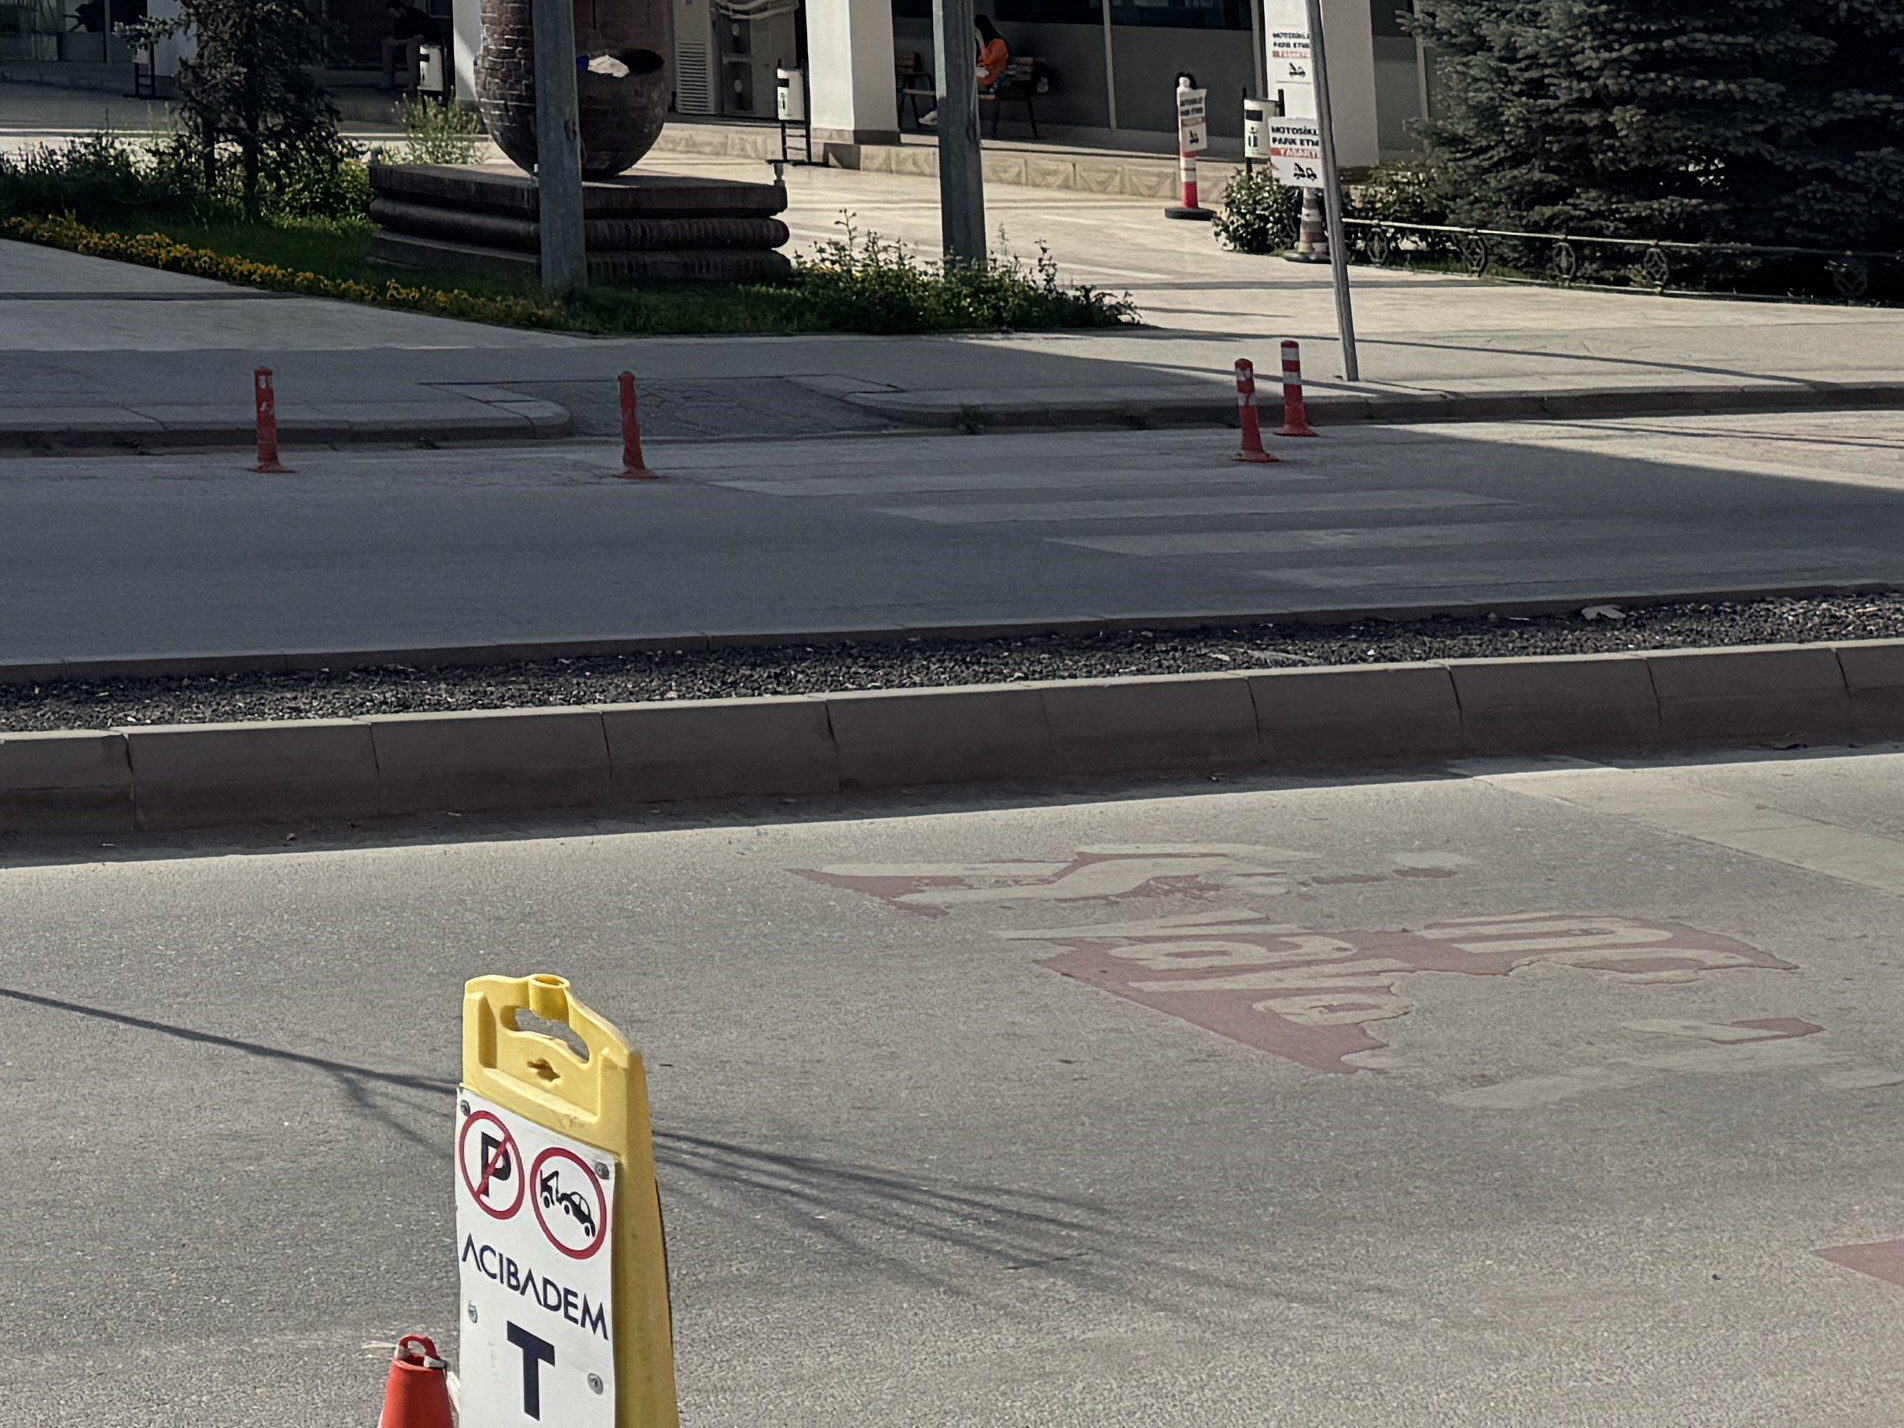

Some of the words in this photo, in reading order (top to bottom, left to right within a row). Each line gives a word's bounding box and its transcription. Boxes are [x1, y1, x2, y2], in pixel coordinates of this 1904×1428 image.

[1271, 125, 1318, 136] MOTOSİKL
[461, 1233, 609, 1341] ACIBADEM
[507, 1320, 555, 1421] T
